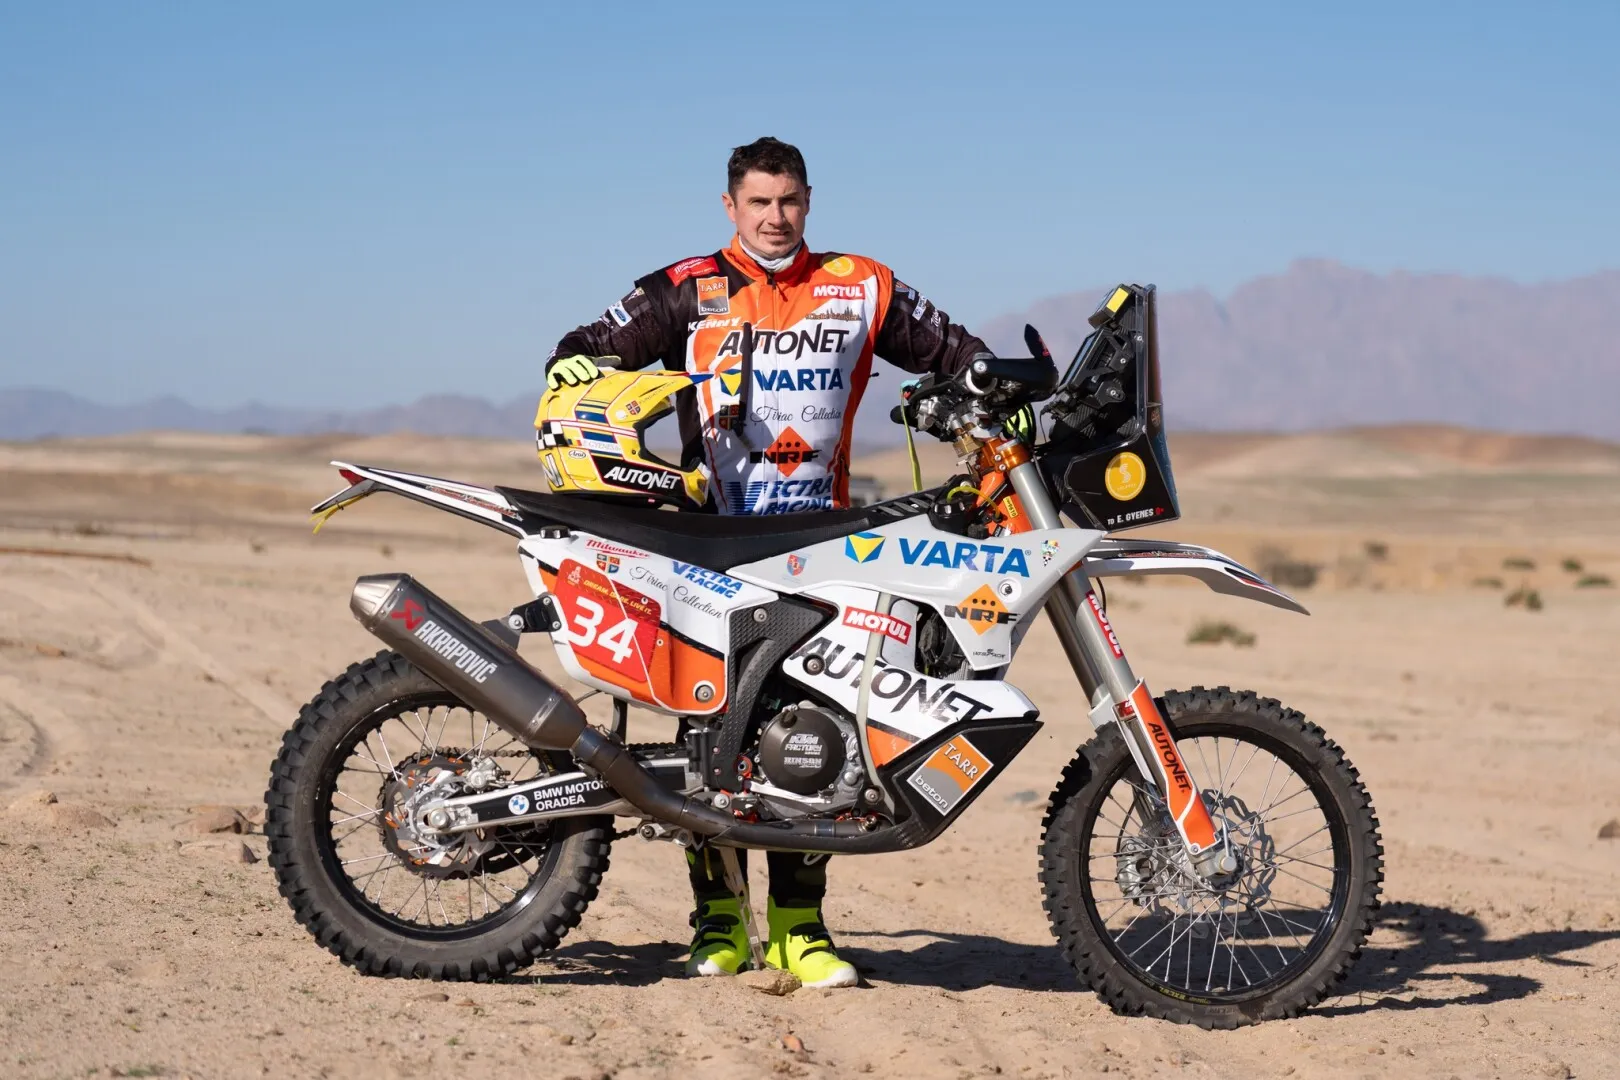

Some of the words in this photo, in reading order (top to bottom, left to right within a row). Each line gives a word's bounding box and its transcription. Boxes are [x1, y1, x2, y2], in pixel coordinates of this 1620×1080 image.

[813, 284, 863, 297] MOTUL
[688, 316, 741, 331] KENNY
[753, 368, 844, 391] VARTA
[801, 405, 842, 423] Collection
[750, 449, 822, 464] NRF
[604, 466, 681, 490] AUTONET
[1125, 508, 1154, 521] GYENES
[585, 538, 650, 558] Milwaukee
[898, 537, 1031, 578] VARTA
[672, 561, 743, 591] VECTRA
[685, 573, 737, 599] RACING
[673, 584, 722, 619] Collection
[845, 611, 909, 641] MOTUL
[944, 605, 1021, 625] NRF
[567, 596, 638, 664] 34
[788, 636, 995, 723] AUTONET
[943, 742, 979, 780] TARR
[1148, 722, 1192, 791] AUTONET
[533, 786, 563, 801] BMW
[535, 794, 586, 811] ORADEA
[914, 774, 949, 809] beton
